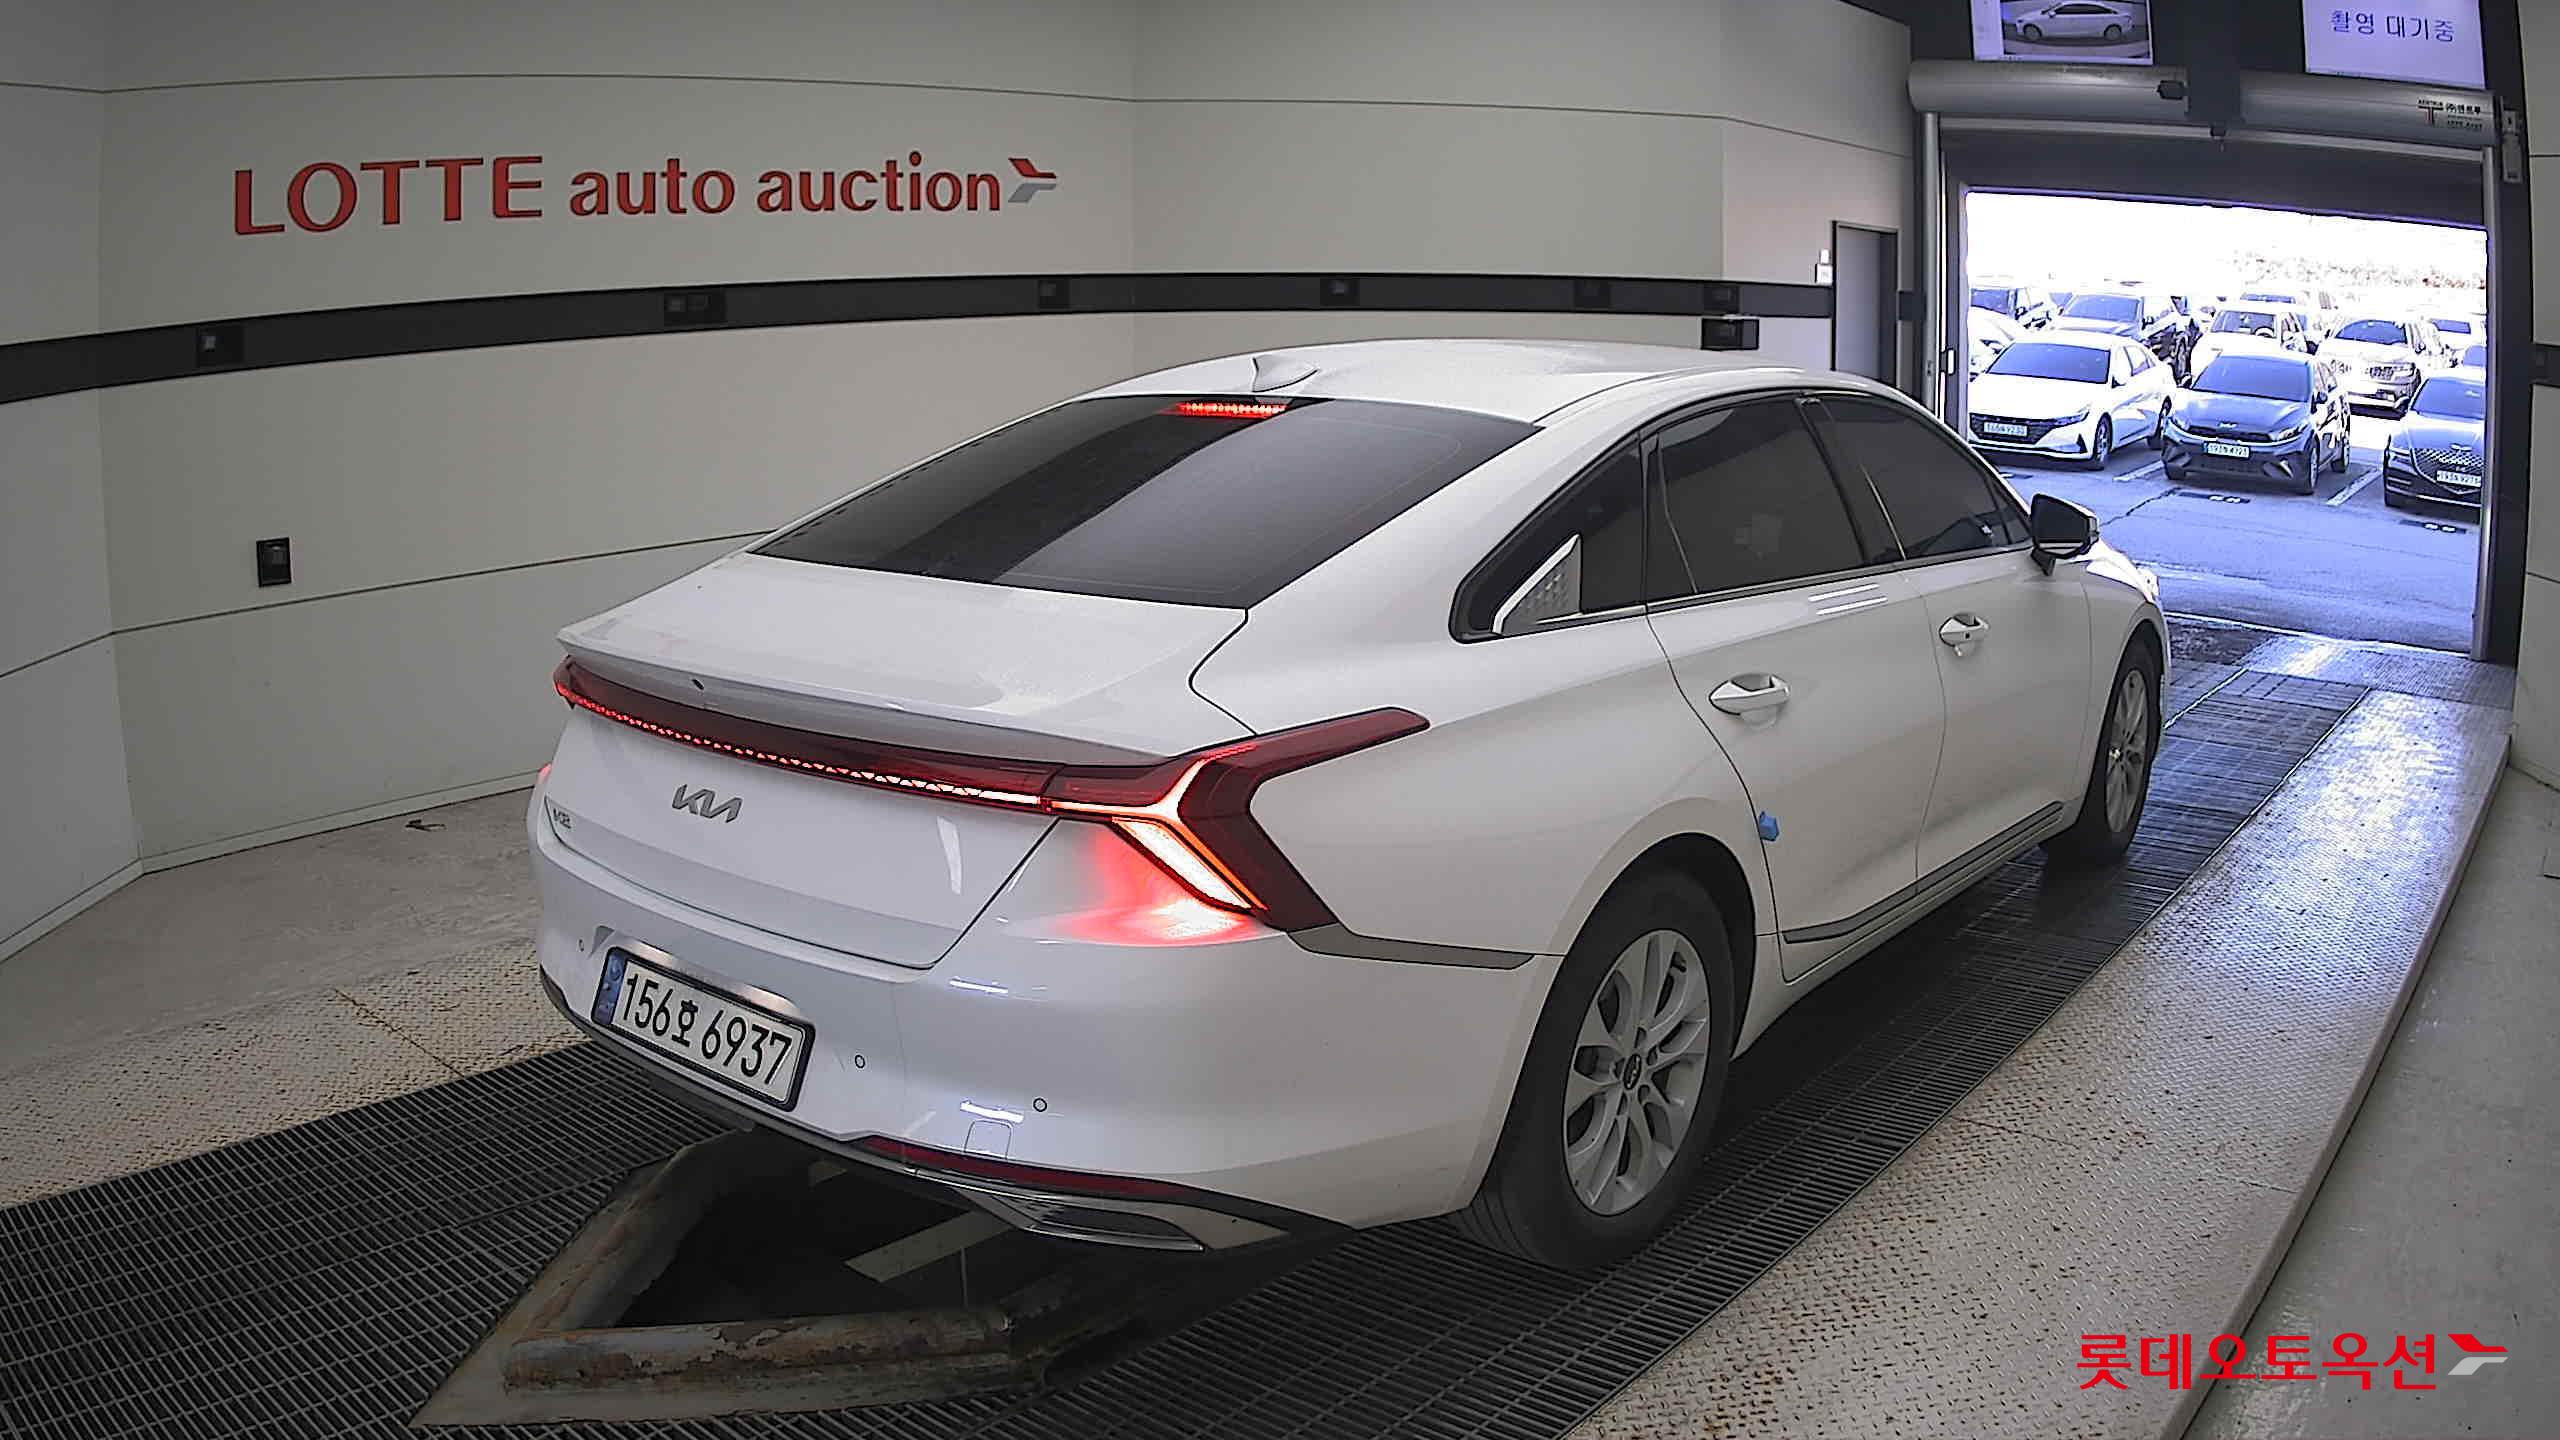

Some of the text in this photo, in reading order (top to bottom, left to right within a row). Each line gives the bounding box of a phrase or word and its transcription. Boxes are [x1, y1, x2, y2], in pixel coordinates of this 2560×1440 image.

[2330, 9, 2455, 43] 촬영 대기중
[233, 151, 1001, 236] LOTTE auto auction
[671, 783, 744, 824] KIA
[622, 972, 793, 1085] 156호 6937
